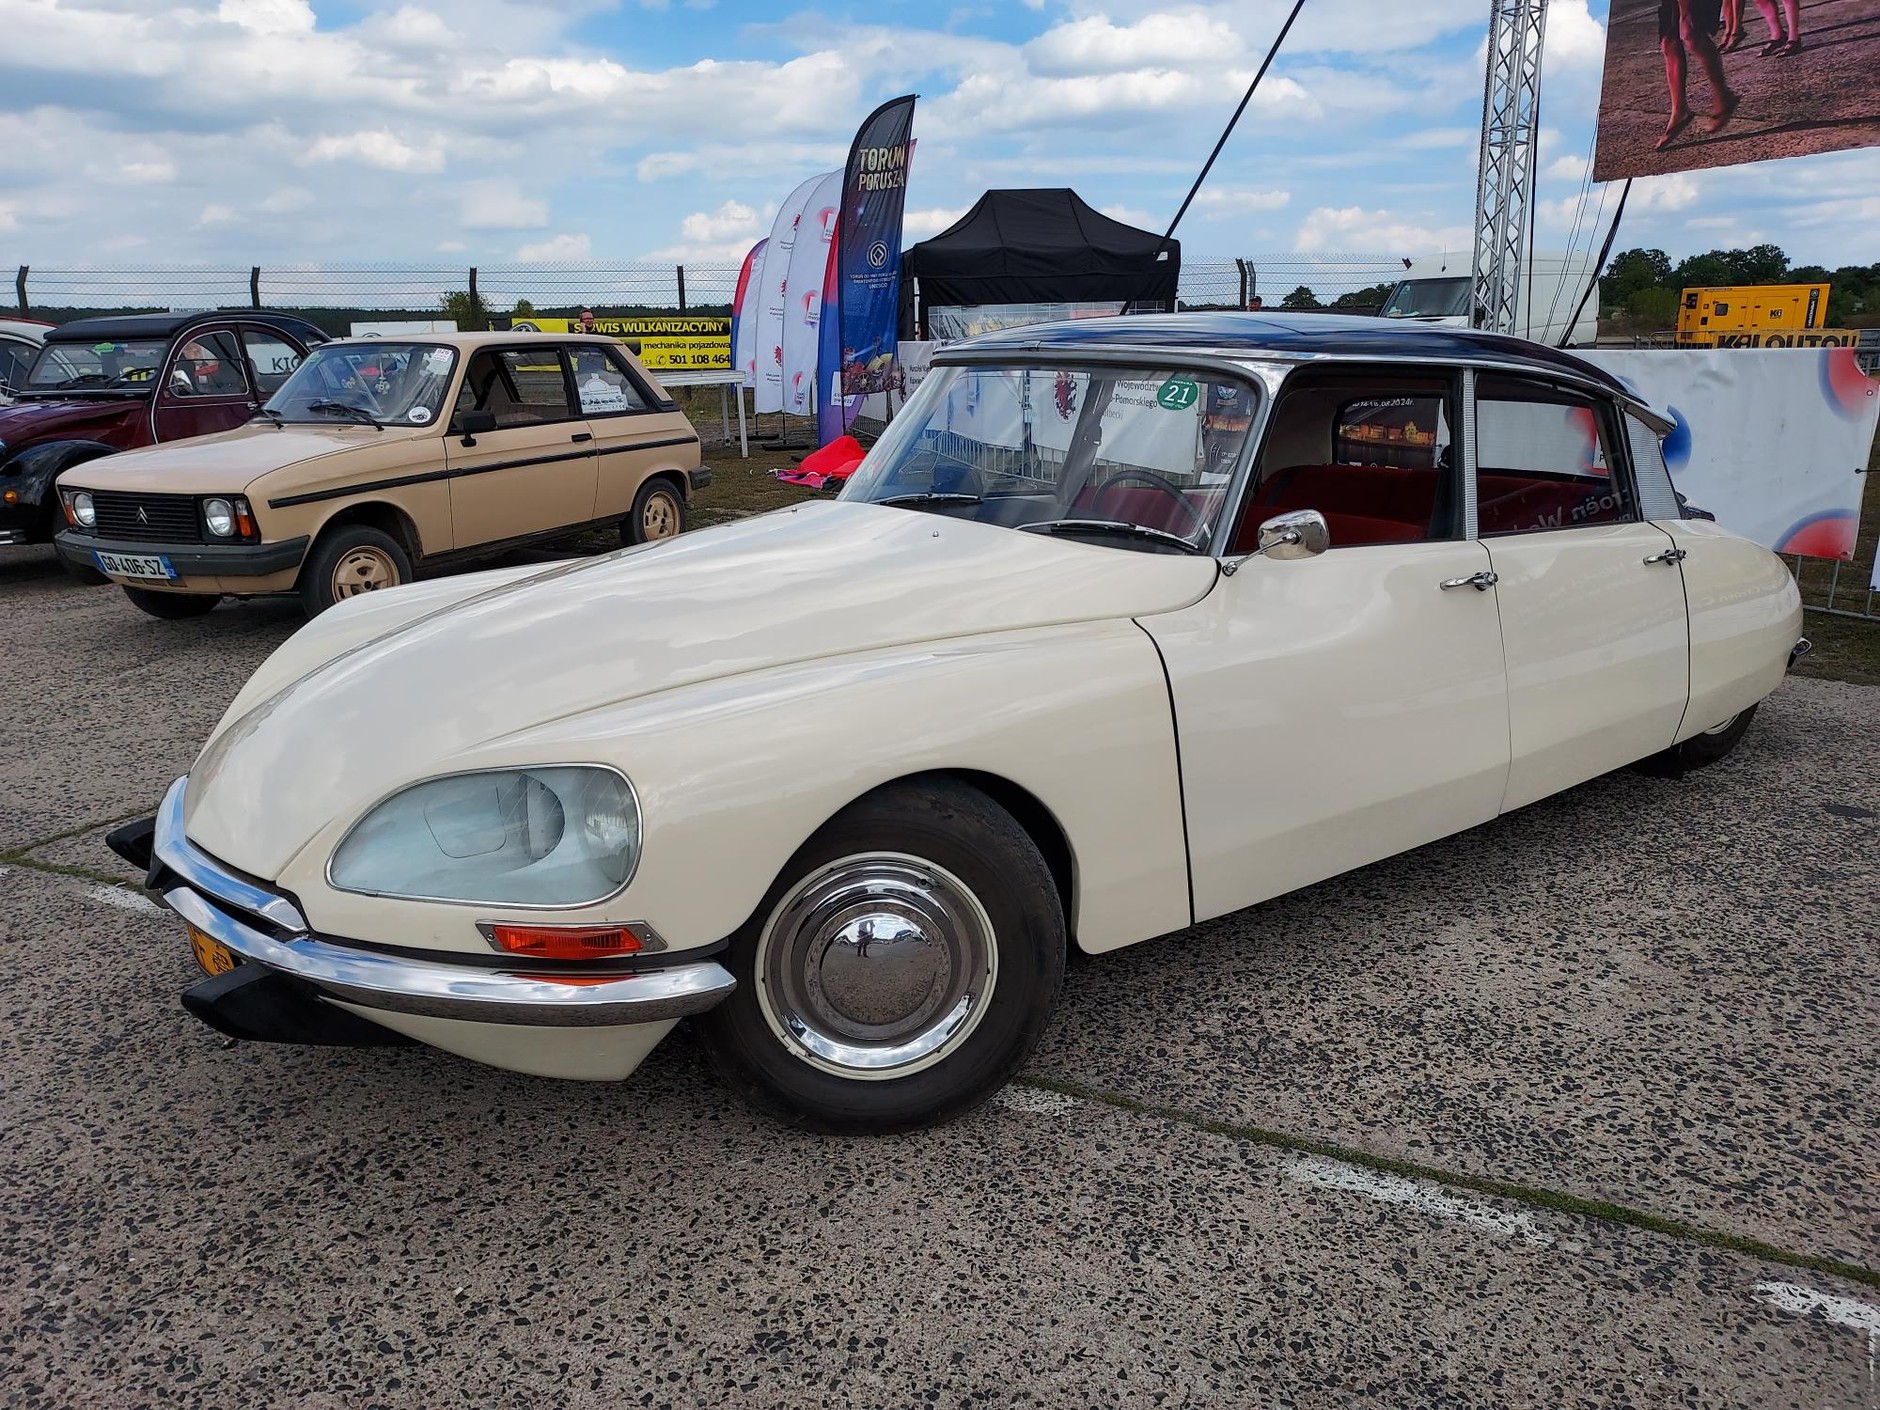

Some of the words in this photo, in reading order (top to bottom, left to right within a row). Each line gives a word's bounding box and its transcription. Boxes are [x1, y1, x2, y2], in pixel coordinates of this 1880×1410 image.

[858, 169, 905, 191] PORUSZA
[621, 321, 724, 333] WULKANIZACYJNY
[644, 341, 686, 349] mechanika
[688, 341, 731, 350] pojazdowa
[669, 355, 686, 364] 501
[691, 355, 709, 364] 108
[712, 355, 731, 364] 464
[1164, 385, 1190, 404] 21
